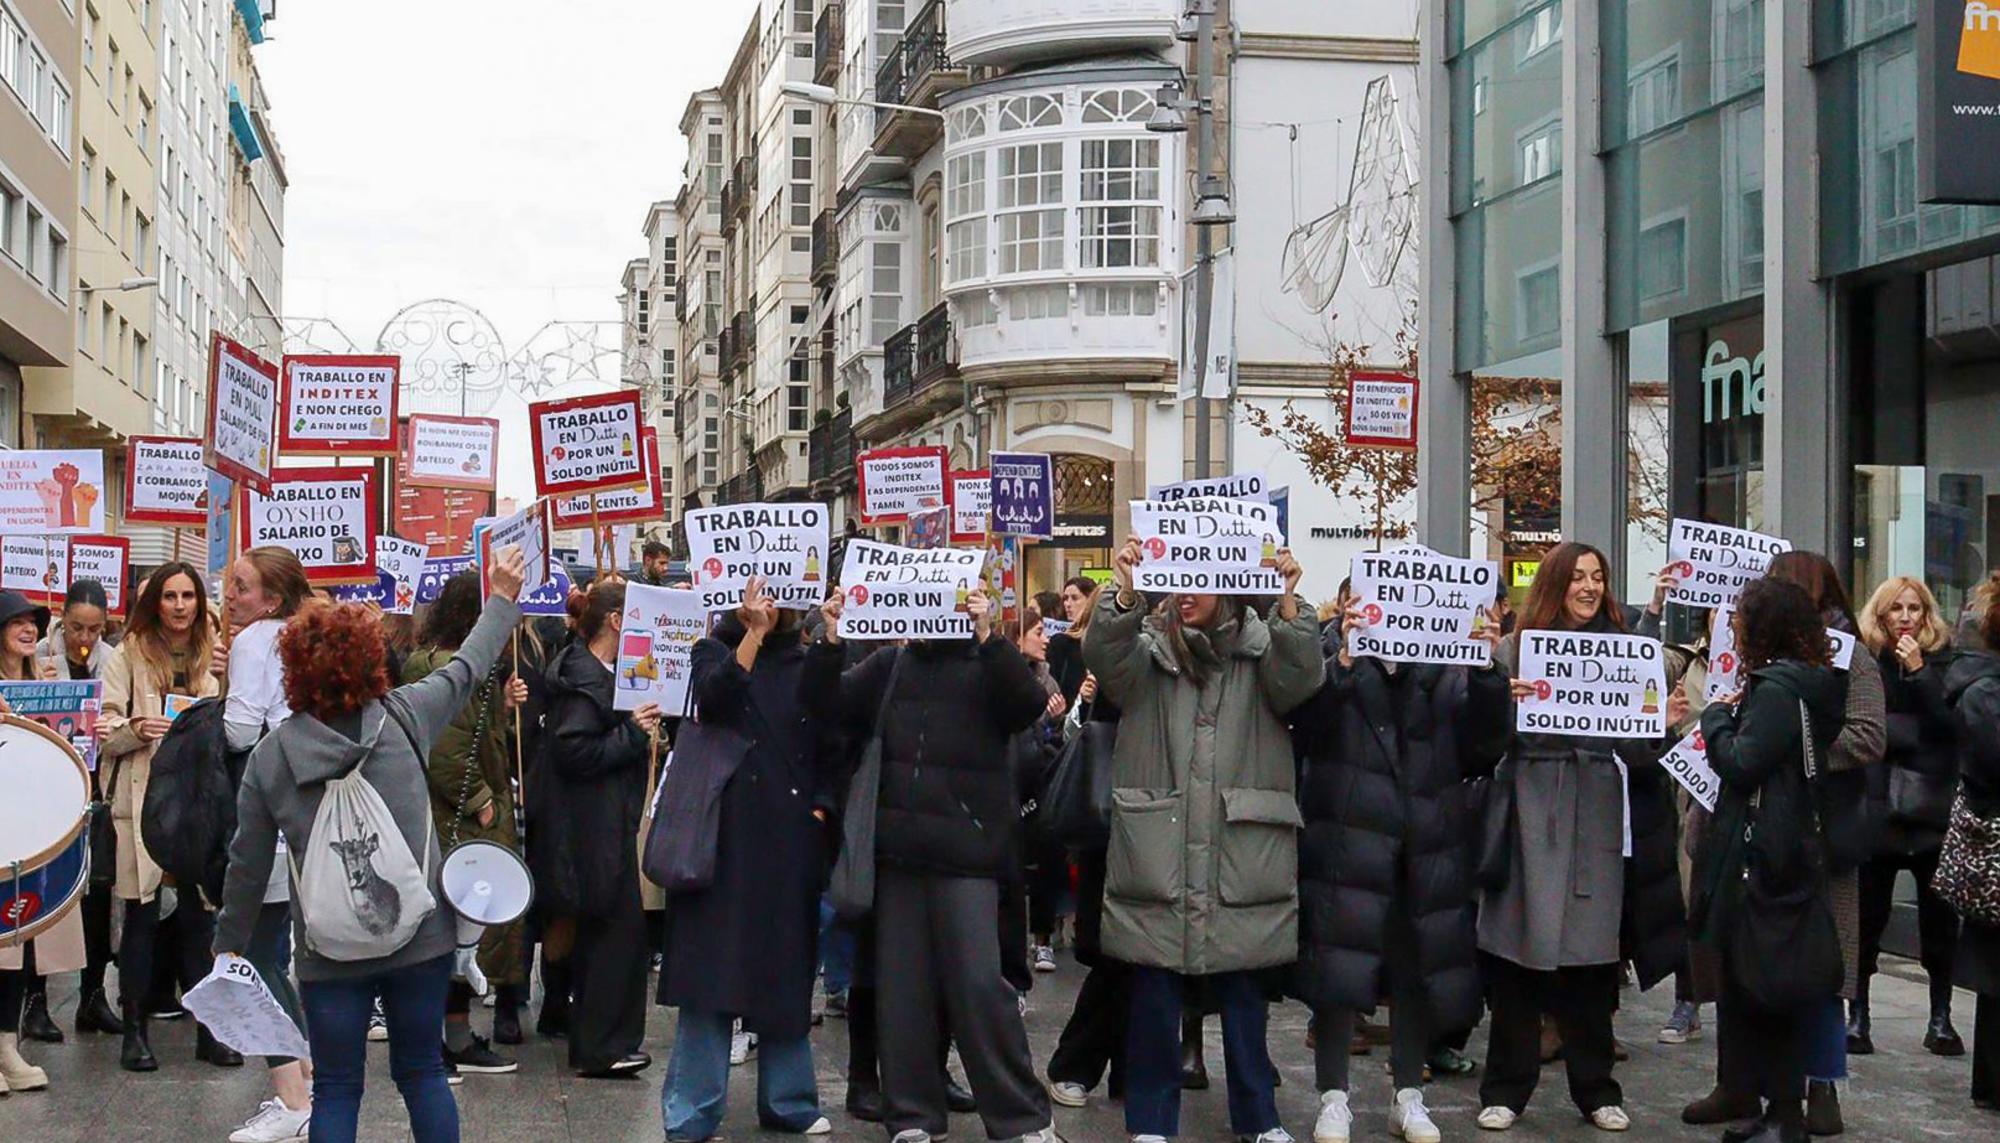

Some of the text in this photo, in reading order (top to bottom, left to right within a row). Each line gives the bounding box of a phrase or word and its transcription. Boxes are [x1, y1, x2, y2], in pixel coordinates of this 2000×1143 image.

[1965, 1, 2000, 31] fn
[224, 362, 268, 400] TRABALLO
[298, 372, 386, 383] TRABALLO EN
[1701, 339, 1765, 424] fna
[300, 388, 378, 399] INDITEX
[231, 388, 262, 422] EN PULL
[296, 404, 383, 416] E NON CHEGO
[220, 408, 247, 434] SALARIO
[248, 424, 257, 439] DE
[310, 422, 369, 431] A FIN DE MES
[548, 408, 628, 430] TRABALLO
[559, 426, 618, 444] EN Dutti
[139, 448, 201, 461] TRABALLO
[415, 455, 455, 465] ARTEIXO
[568, 445, 615, 461] POR UN
[1, 460, 38, 470] UELGA
[551, 459, 637, 481] SOLDO INÚTIL
[869, 460, 935, 472] TODOS SOMOS
[0, 481, 39, 491] NDITEX
[137, 475, 143, 485] E
[144, 476, 203, 487] COBRAMOS
[884, 473, 922, 483] INDITEX
[958, 481, 980, 490] NON
[158, 489, 195, 503] MOJÓN
[340, 486, 361, 499] EN
[867, 484, 940, 496] E AS DEPENDENTAS
[1158, 477, 1261, 502] TRABALLO
[567, 495, 639, 512] INDCENTES
[266, 504, 344, 523] OYSHO
[694, 509, 819, 532] TRABALLO
[258, 524, 350, 540] SALARIO DE
[1158, 515, 1256, 539] EN Dutti
[713, 529, 801, 554] EN Dutti
[1681, 525, 1783, 556] TRABALLO
[3, 545, 44, 557] ROUBANME
[56, 549, 65, 559] DE
[79, 547, 115, 559] SOMOS
[296, 547, 323, 560] IXO
[401, 544, 422, 558] EN
[856, 545, 975, 566] TRABALLO
[1171, 546, 1247, 561] POR UN
[1689, 547, 1764, 572] EN Dutti
[3, 565, 37, 577] ARTEIXO
[72, 560, 100, 571] DITEX
[726, 561, 792, 578] POR UN
[1362, 558, 1490, 586] TRABALLO
[864, 566, 952, 585] EN Dutti
[1142, 569, 1282, 589] SOLDO INÚTIL
[1695, 570, 1728, 586] POR
[702, 589, 747, 608] SOLD
[872, 592, 942, 609] POR UN
[1377, 583, 1470, 610] EN Dutti
[1669, 586, 1722, 605] SOLDO
[845, 614, 974, 634] SOLDO INÚTIL
[1386, 614, 1459, 633] POR UN
[654, 643, 673, 653] NON
[1357, 636, 1486, 660] SOLDO INÚTIL
[1530, 636, 1655, 660] TRABALLO
[1545, 659, 1640, 684] EN Dutti
[1556, 689, 1629, 707] POR UN
[1525, 713, 1661, 733] SOLDO INÚTIL
[1665, 751, 1709, 794] SOLDO
